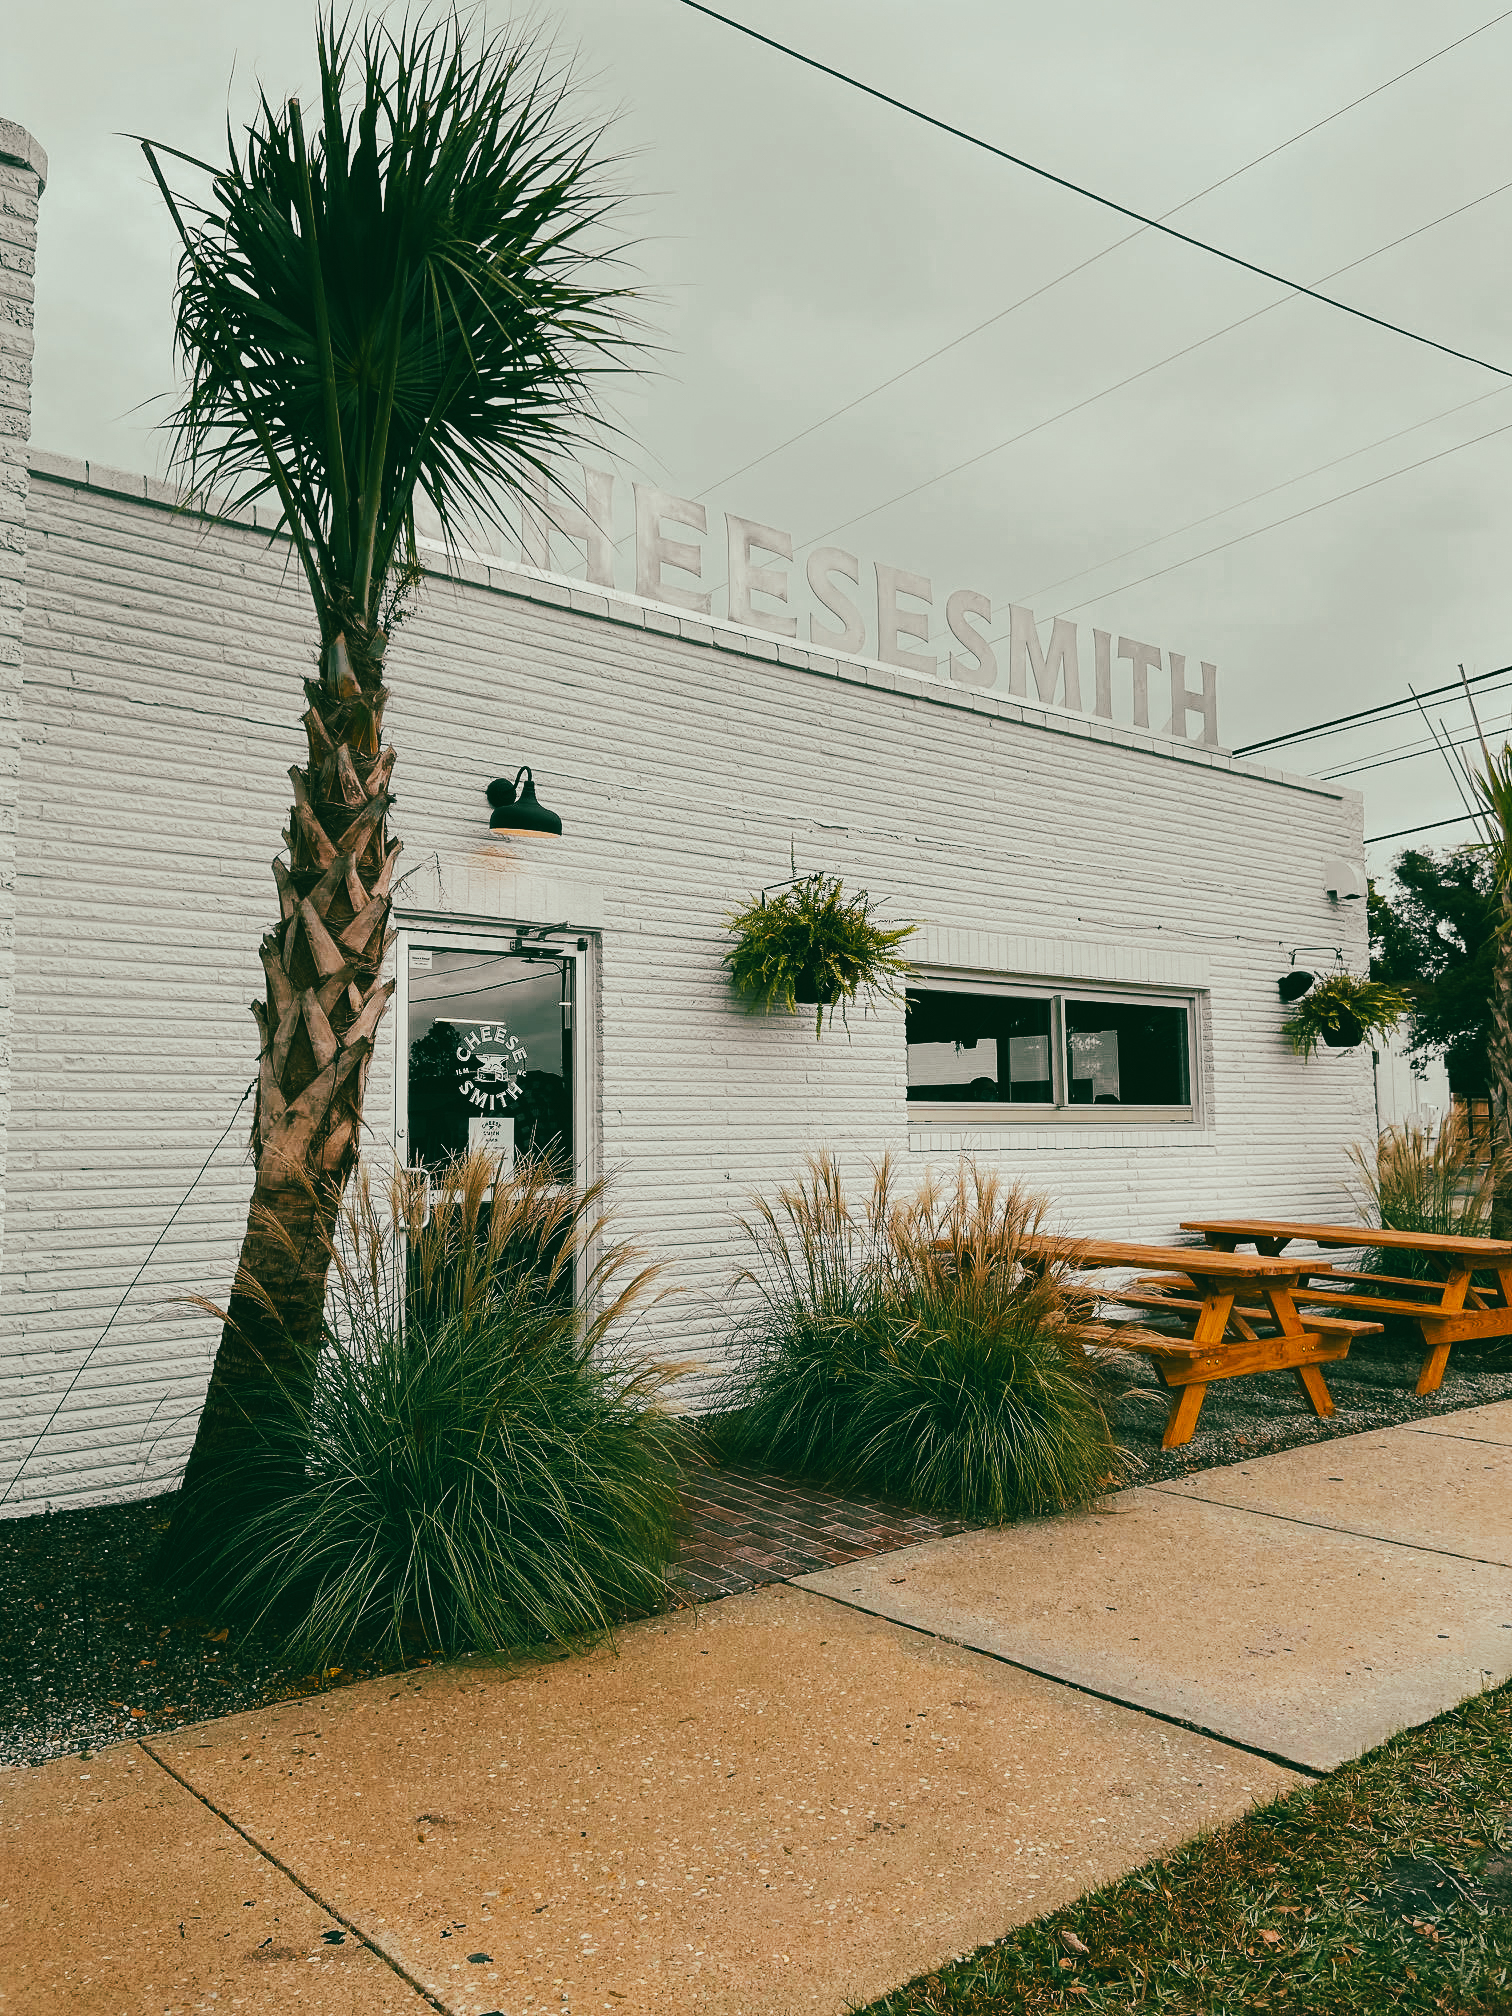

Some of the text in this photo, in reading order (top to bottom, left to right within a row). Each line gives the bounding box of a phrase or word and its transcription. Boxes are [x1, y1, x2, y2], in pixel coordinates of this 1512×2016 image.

[456, 1025, 528, 1063] CHEESE
[516, 1068, 527, 1078] NC
[458, 1080, 523, 1111] SMITH
